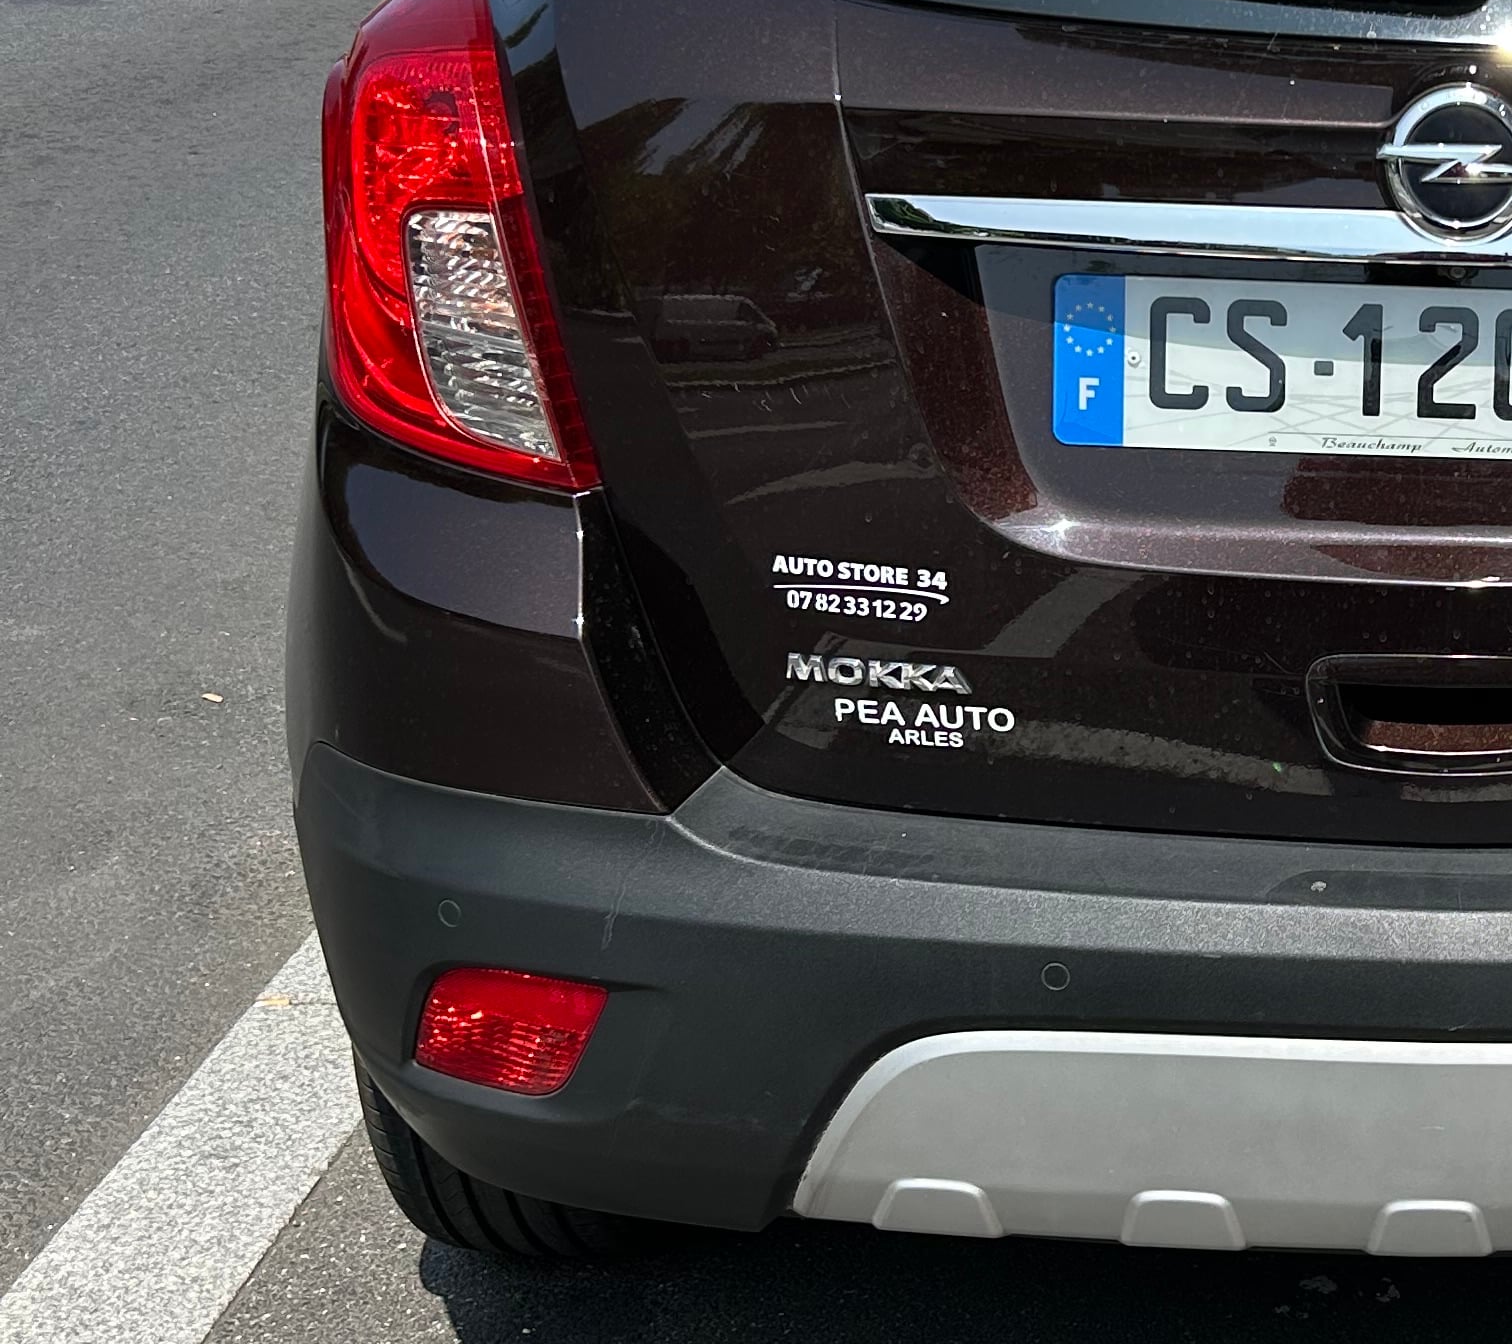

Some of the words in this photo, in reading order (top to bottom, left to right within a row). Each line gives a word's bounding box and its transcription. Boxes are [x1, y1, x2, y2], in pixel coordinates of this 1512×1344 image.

[1078, 377, 1096, 411] F
[1322, 437, 1423, 453] Beauchamp
[772, 555, 834, 578] AUTO
[837, 561, 909, 585] STORE
[916, 569, 948, 591] 34
[786, 652, 973, 695] MOKKA
[835, 698, 906, 726] PEA
[915, 703, 1015, 732] AUTO
[888, 728, 964, 748] ARLES
